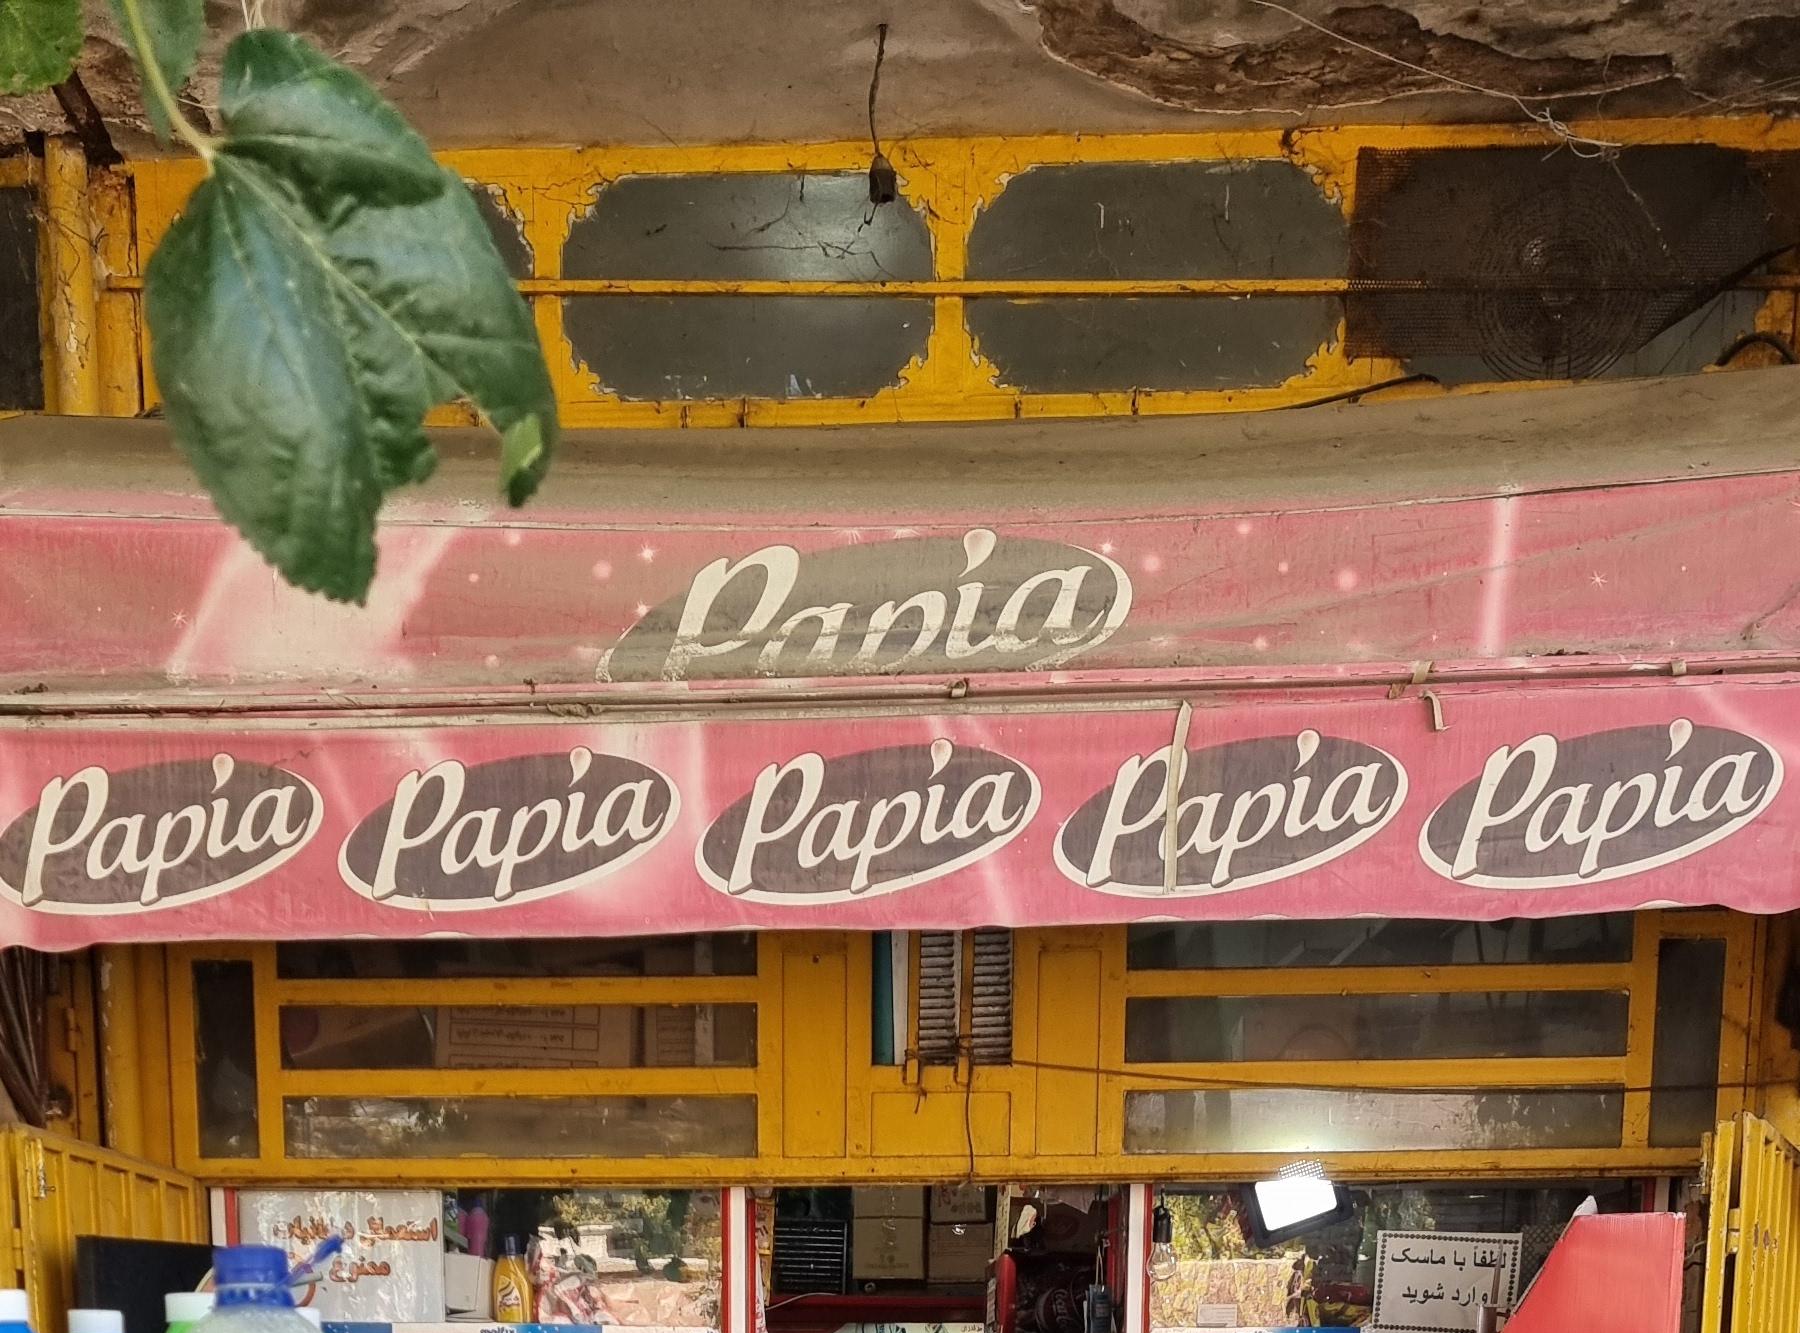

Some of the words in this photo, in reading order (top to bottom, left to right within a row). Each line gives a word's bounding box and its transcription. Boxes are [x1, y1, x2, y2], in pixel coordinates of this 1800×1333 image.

[21, 752, 306, 905] Papia
[371, 745, 665, 900] Papia
[727, 738, 1026, 894] Papia
[1087, 728, 1391, 887] Papia
[1452, 717, 1766, 879] Papia
[1391, 1247, 1446, 1264] ماسک
[1453, 1249, 1466, 1271] با
[1472, 1244, 1507, 1269] لطفاً
[329, 1254, 391, 1283] ممنوع
[1402, 1282, 1445, 1305] شوید
[1451, 1286, 1488, 1307] وارد
